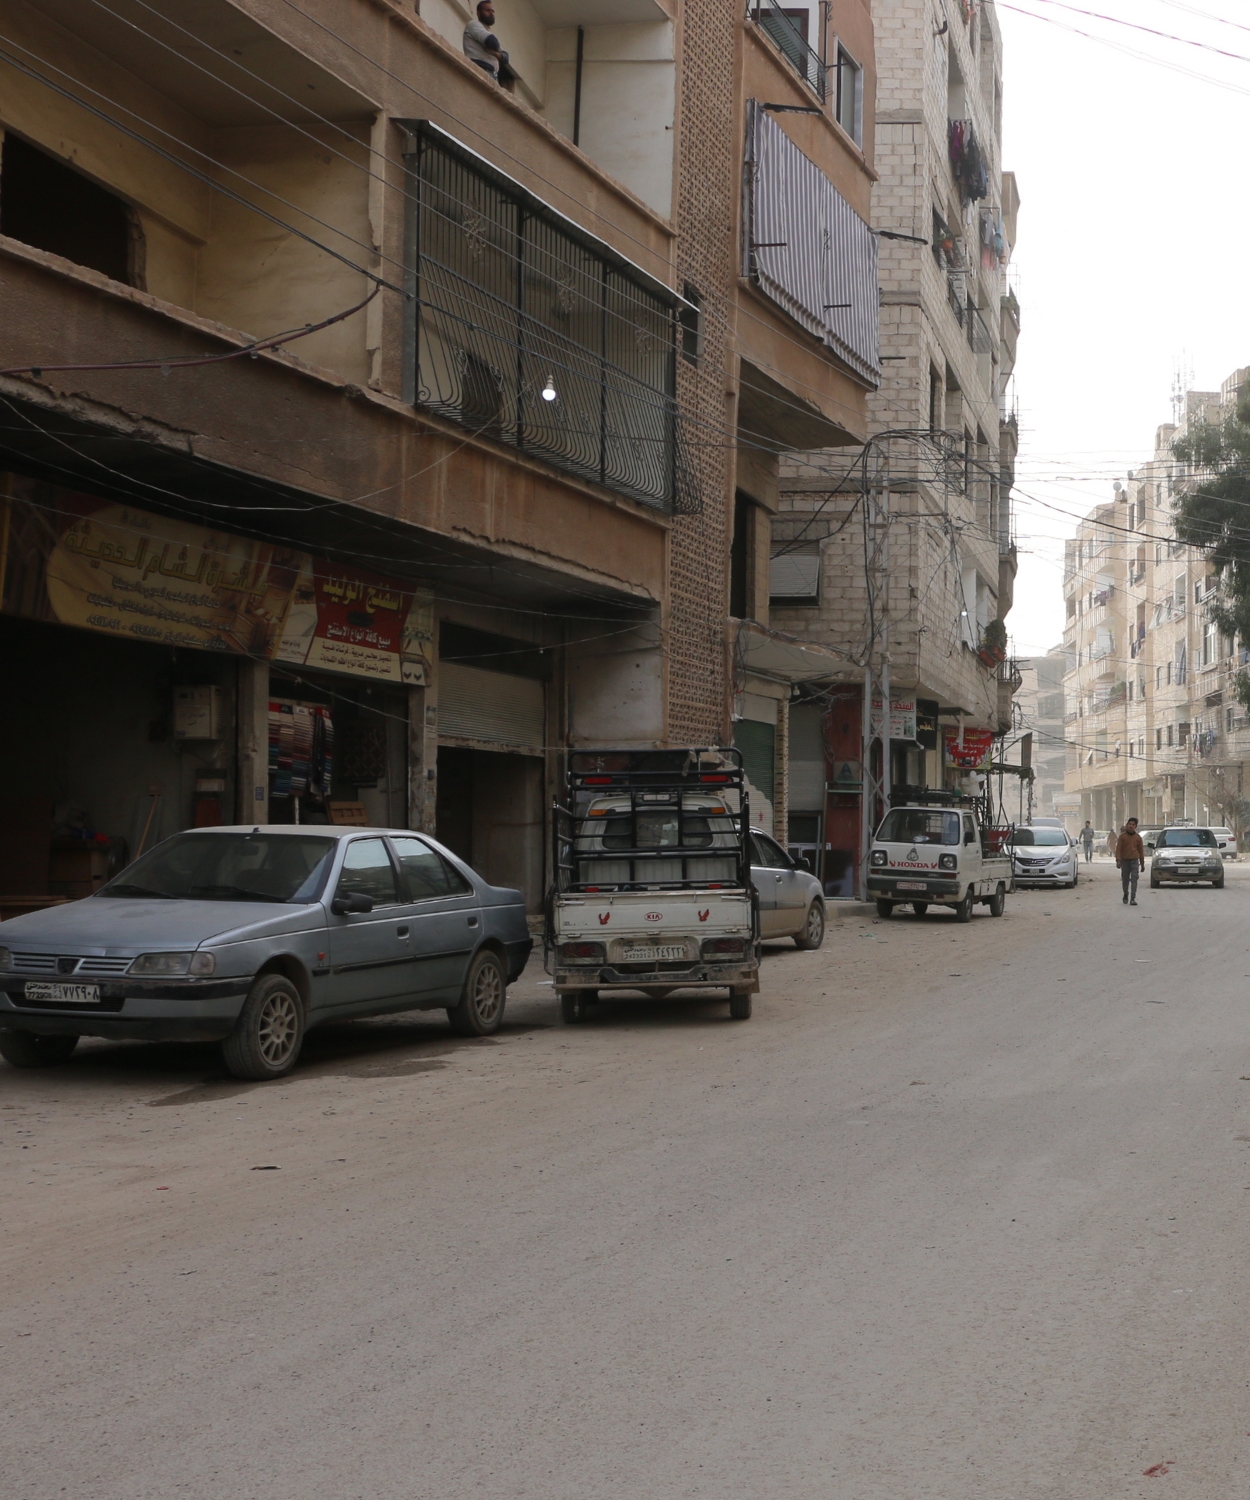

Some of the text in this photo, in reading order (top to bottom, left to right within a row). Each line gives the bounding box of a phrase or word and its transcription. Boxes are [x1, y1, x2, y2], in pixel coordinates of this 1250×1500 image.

[65, 521, 149, 573] الحديثة
[143, 543, 209, 584] الشام
[322, 573, 364, 606] الوليد
[366, 630, 378, 643] كافة
[378, 637, 391, 649] مبيع
[897, 861, 929, 869] HONDA
[62, 985, 100, 1001] ٧٧٢٩٠٨
